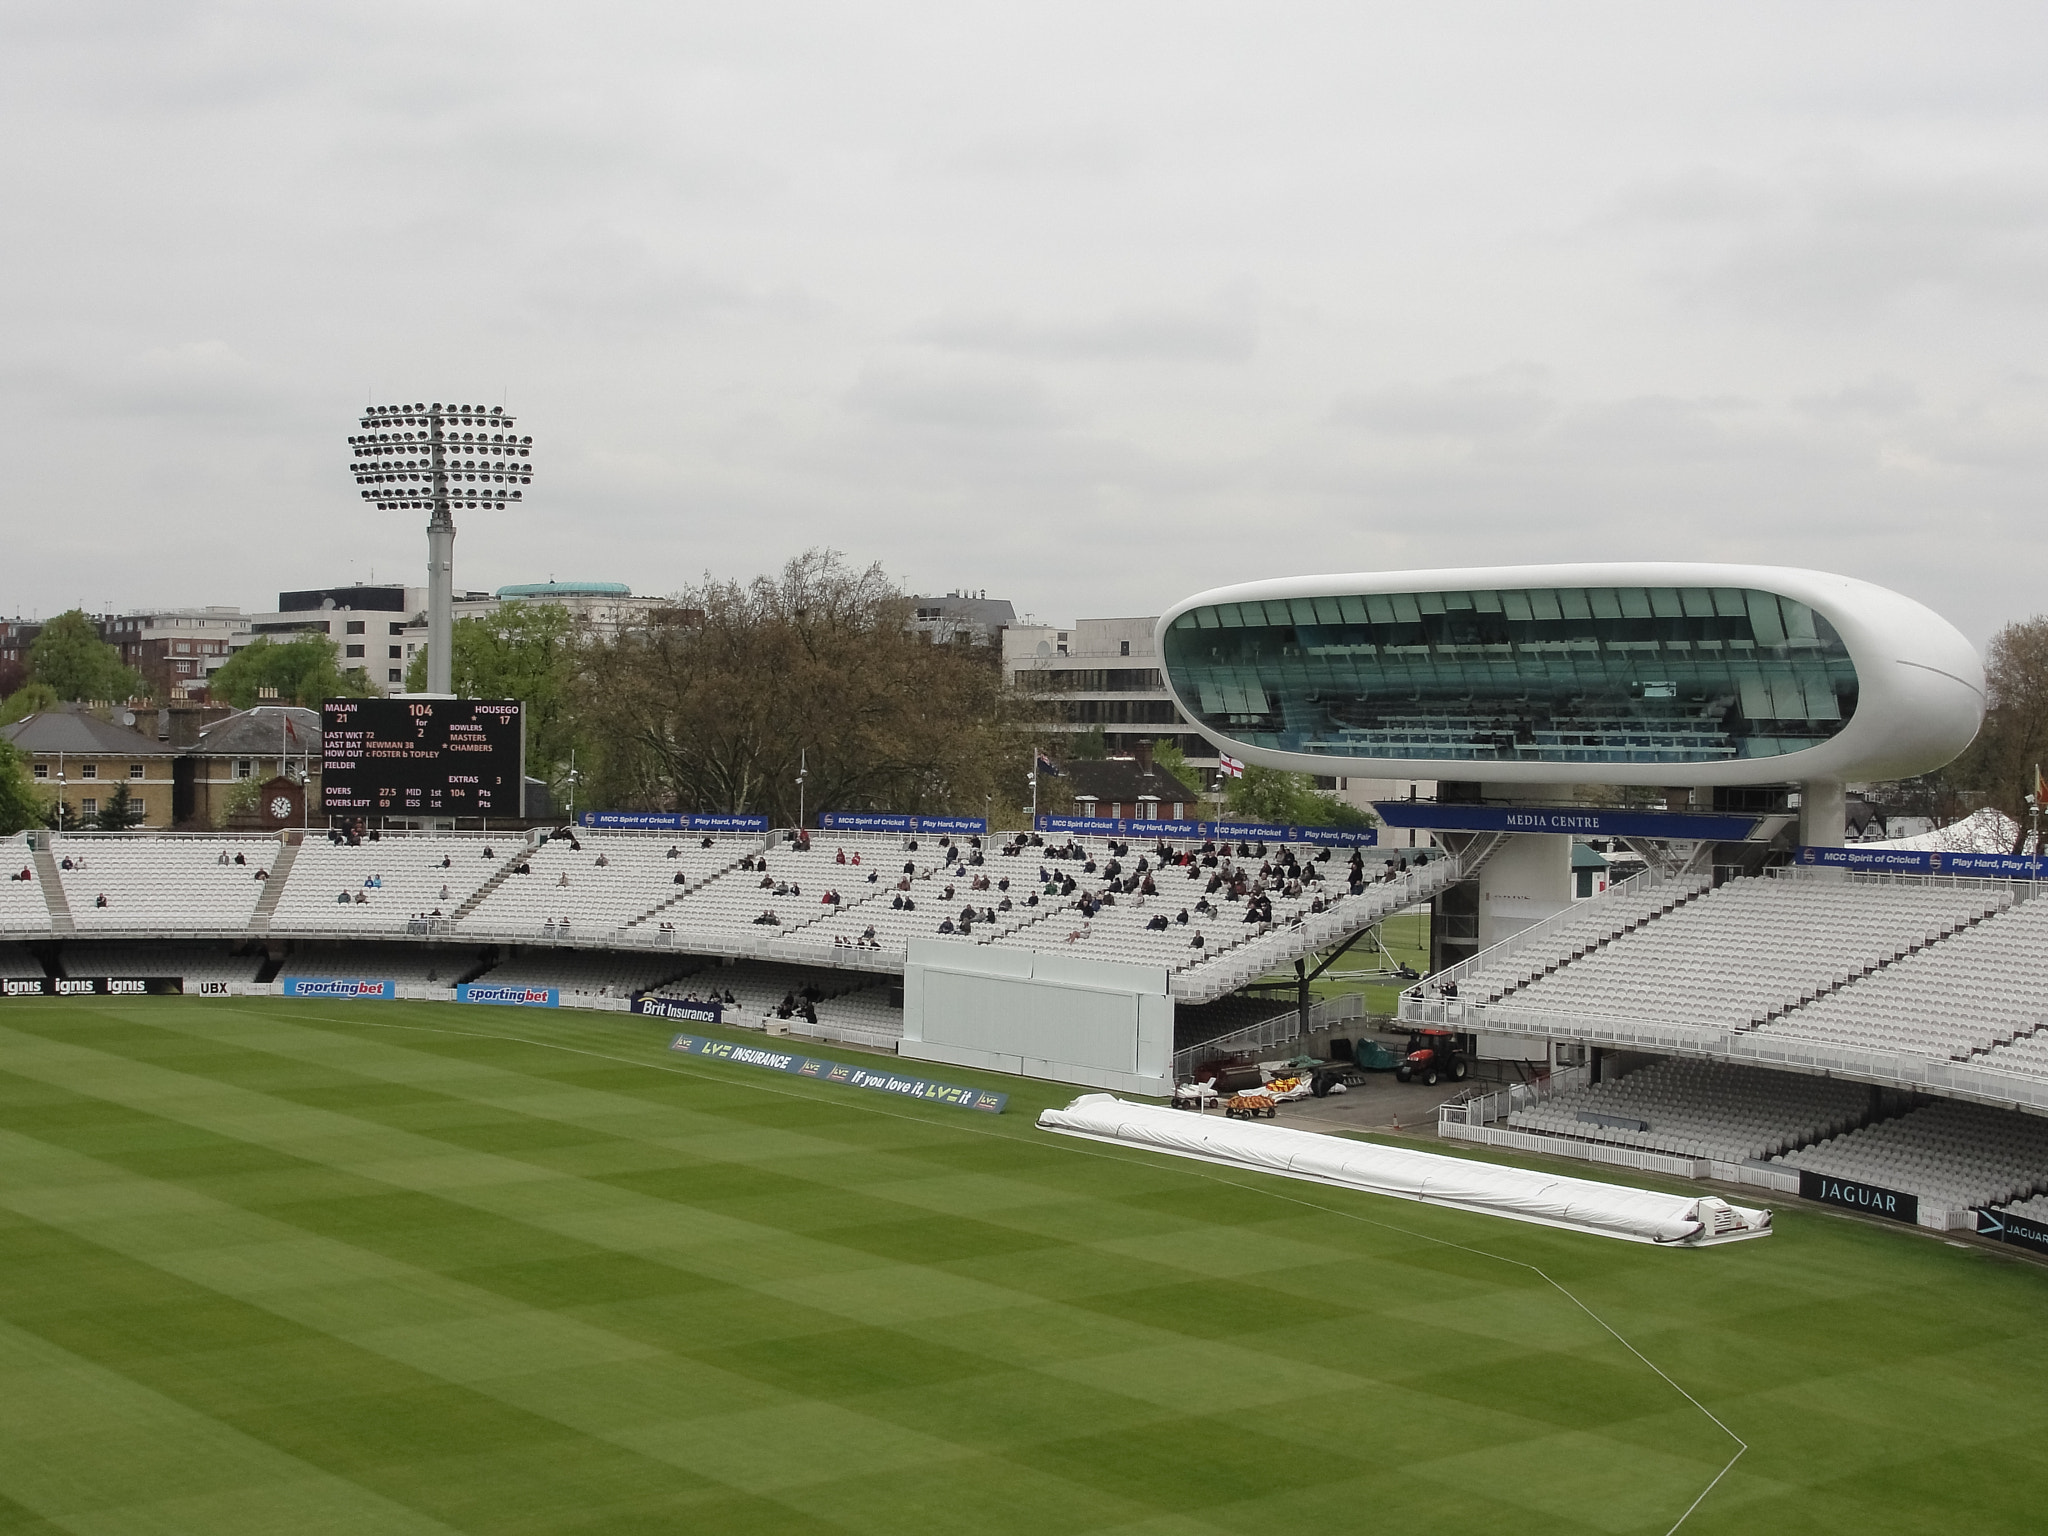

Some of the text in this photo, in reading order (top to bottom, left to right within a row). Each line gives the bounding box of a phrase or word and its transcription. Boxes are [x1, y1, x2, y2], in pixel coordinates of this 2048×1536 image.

[325, 703, 358, 712] MALAN
[408, 703, 433, 717] 104
[475, 705, 519, 714] HOUSEGO
[336, 713, 348, 723] 21
[415, 718, 428, 727] for
[499, 715, 511, 725] 17
[417, 728, 424, 738] 2
[449, 724, 483, 732] BOWLERS
[324, 731, 344, 739] LAST
[345, 731, 363, 739] WKT
[450, 734, 487, 742] MASTERS
[325, 741, 344, 749] LAST
[345, 741, 362, 749] BAT
[366, 741, 403, 749] NEWMAN
[450, 744, 493, 752] CHAMBERS
[325, 750, 345, 758] HOW
[346, 750, 363, 758] OUT
[372, 750, 401, 758] FOSTER
[410, 751, 440, 759] TOPLEY
[324, 761, 356, 769] FIELDER
[448, 775, 502, 785] EXTRAS 3
[325, 787, 397, 796] OVERS 27.5
[406, 788, 491, 797] MID 1st 104 Pts
[325, 799, 351, 807] OVERS
[379, 800, 391, 808] 69
[430, 800, 442, 808] 1st
[478, 800, 491, 808] Pts
[619, 816, 639, 824] Spirit
[694, 818, 711, 826] Play
[711, 818, 730, 826] Hard,
[731, 819, 747, 827] Play
[855, 817, 872, 825] Spirit
[881, 818, 905, 826] Cricket
[923, 820, 937, 828] Play
[938, 821, 954, 829] Hard,
[955, 821, 969, 829] Play
[1067, 820, 1083, 828] Spirit
[1091, 821, 1113, 829] Cricket
[1507, 814, 1600, 829] MEDIA CENTRE
[1133, 823, 1146, 831] Play
[1146, 823, 1163, 832] Hard,
[1230, 827, 1248, 835] Spirit
[1257, 828, 1281, 837] Cricket
[1305, 830, 1320, 839] Play
[1321, 832, 1339, 840] Hard,
[1340, 832, 1356, 841] Play
[1824, 852, 1921, 865] MCC Spirit of Cricket
[1952, 858, 1973, 868] Play
[1974, 859, 2000, 869] Hard,
[2001, 860, 2023, 870] Play
[2, 979, 42, 995] ignis
[55, 978, 94, 994] ignis
[107, 978, 146, 994] ignis
[201, 982, 228, 994] UBX
[296, 981, 384, 997] sportingbet
[468, 987, 549, 1004] sportingbet
[643, 1000, 714, 1022] Brit Insurance
[731, 1046, 792, 1070] INSURANCE
[851, 1070, 866, 1083] If
[860, 1074, 884, 1088] you
[885, 1077, 911, 1093] love
[910, 1081, 925, 1098] it,
[958, 1091, 972, 1104] it
[1820, 1180, 1896, 1212] JAGUAR
[2006, 1224, 2048, 1243] JAGUAR
